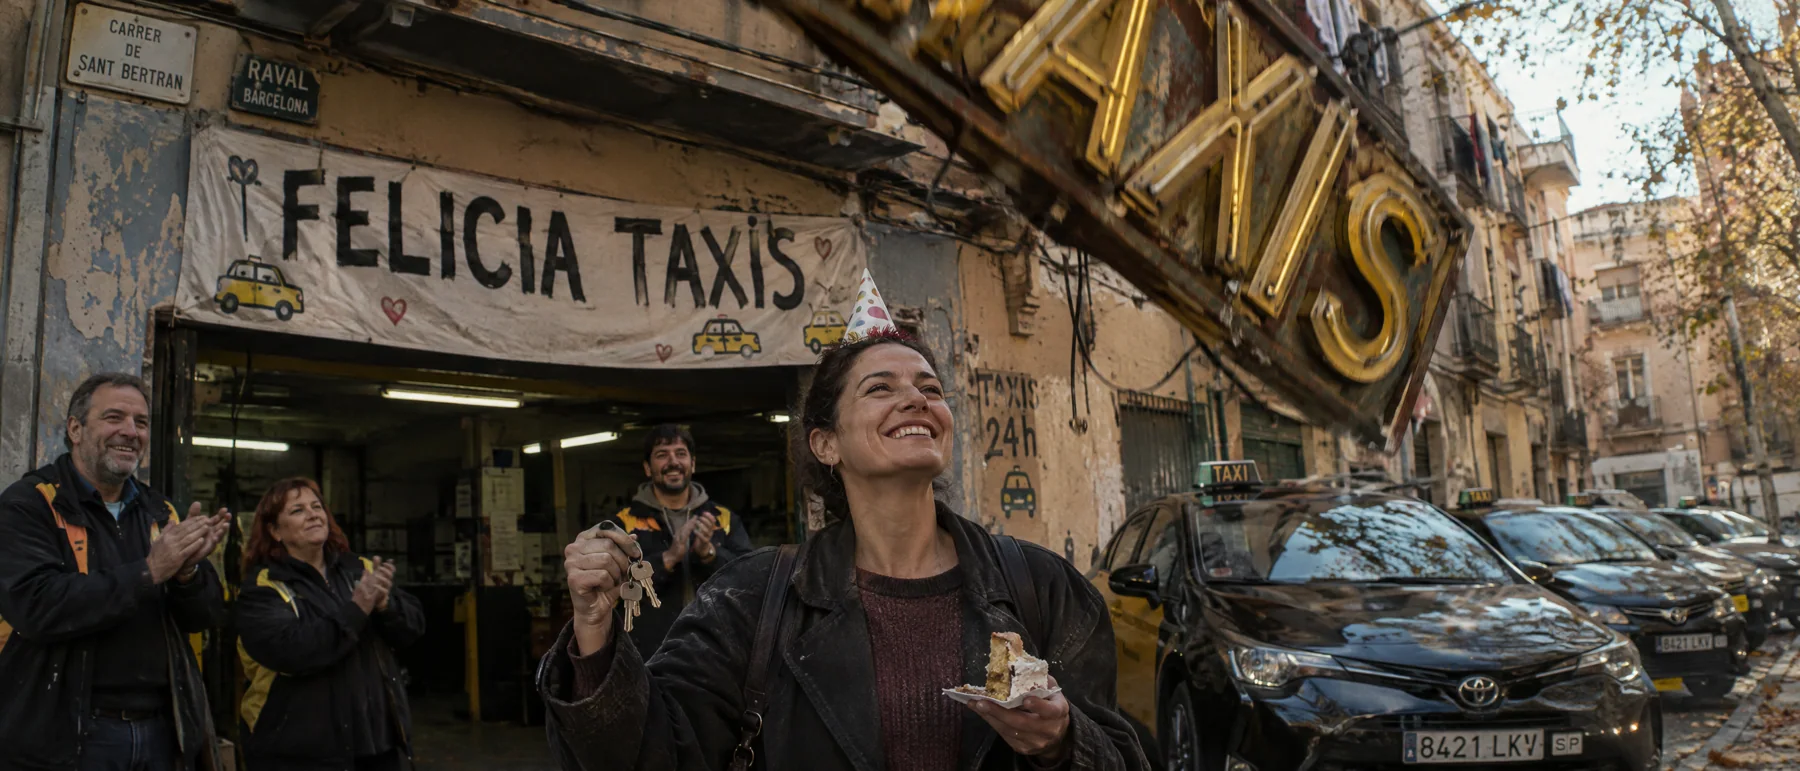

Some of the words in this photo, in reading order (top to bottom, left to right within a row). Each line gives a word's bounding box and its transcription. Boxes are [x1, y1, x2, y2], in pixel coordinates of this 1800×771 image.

[109, 19, 162, 44] CARRER
[125, 44, 141, 59] DE
[78, 54, 115, 76] SANT
[121, 63, 183, 91] BERTRAN
[248, 60, 309, 92] RAVAL
[243, 87, 309, 115] BARCELONA
[916, 0, 1434, 384] AXIS
[283, 169, 586, 303] FELICIA
[985, 415, 1037, 460] 24h
[1213, 464, 1248, 483] TAXI
[1420, 735, 1480, 759] 8421
[1493, 733, 1537, 757] LKV
[1554, 737, 1580, 751] SP
